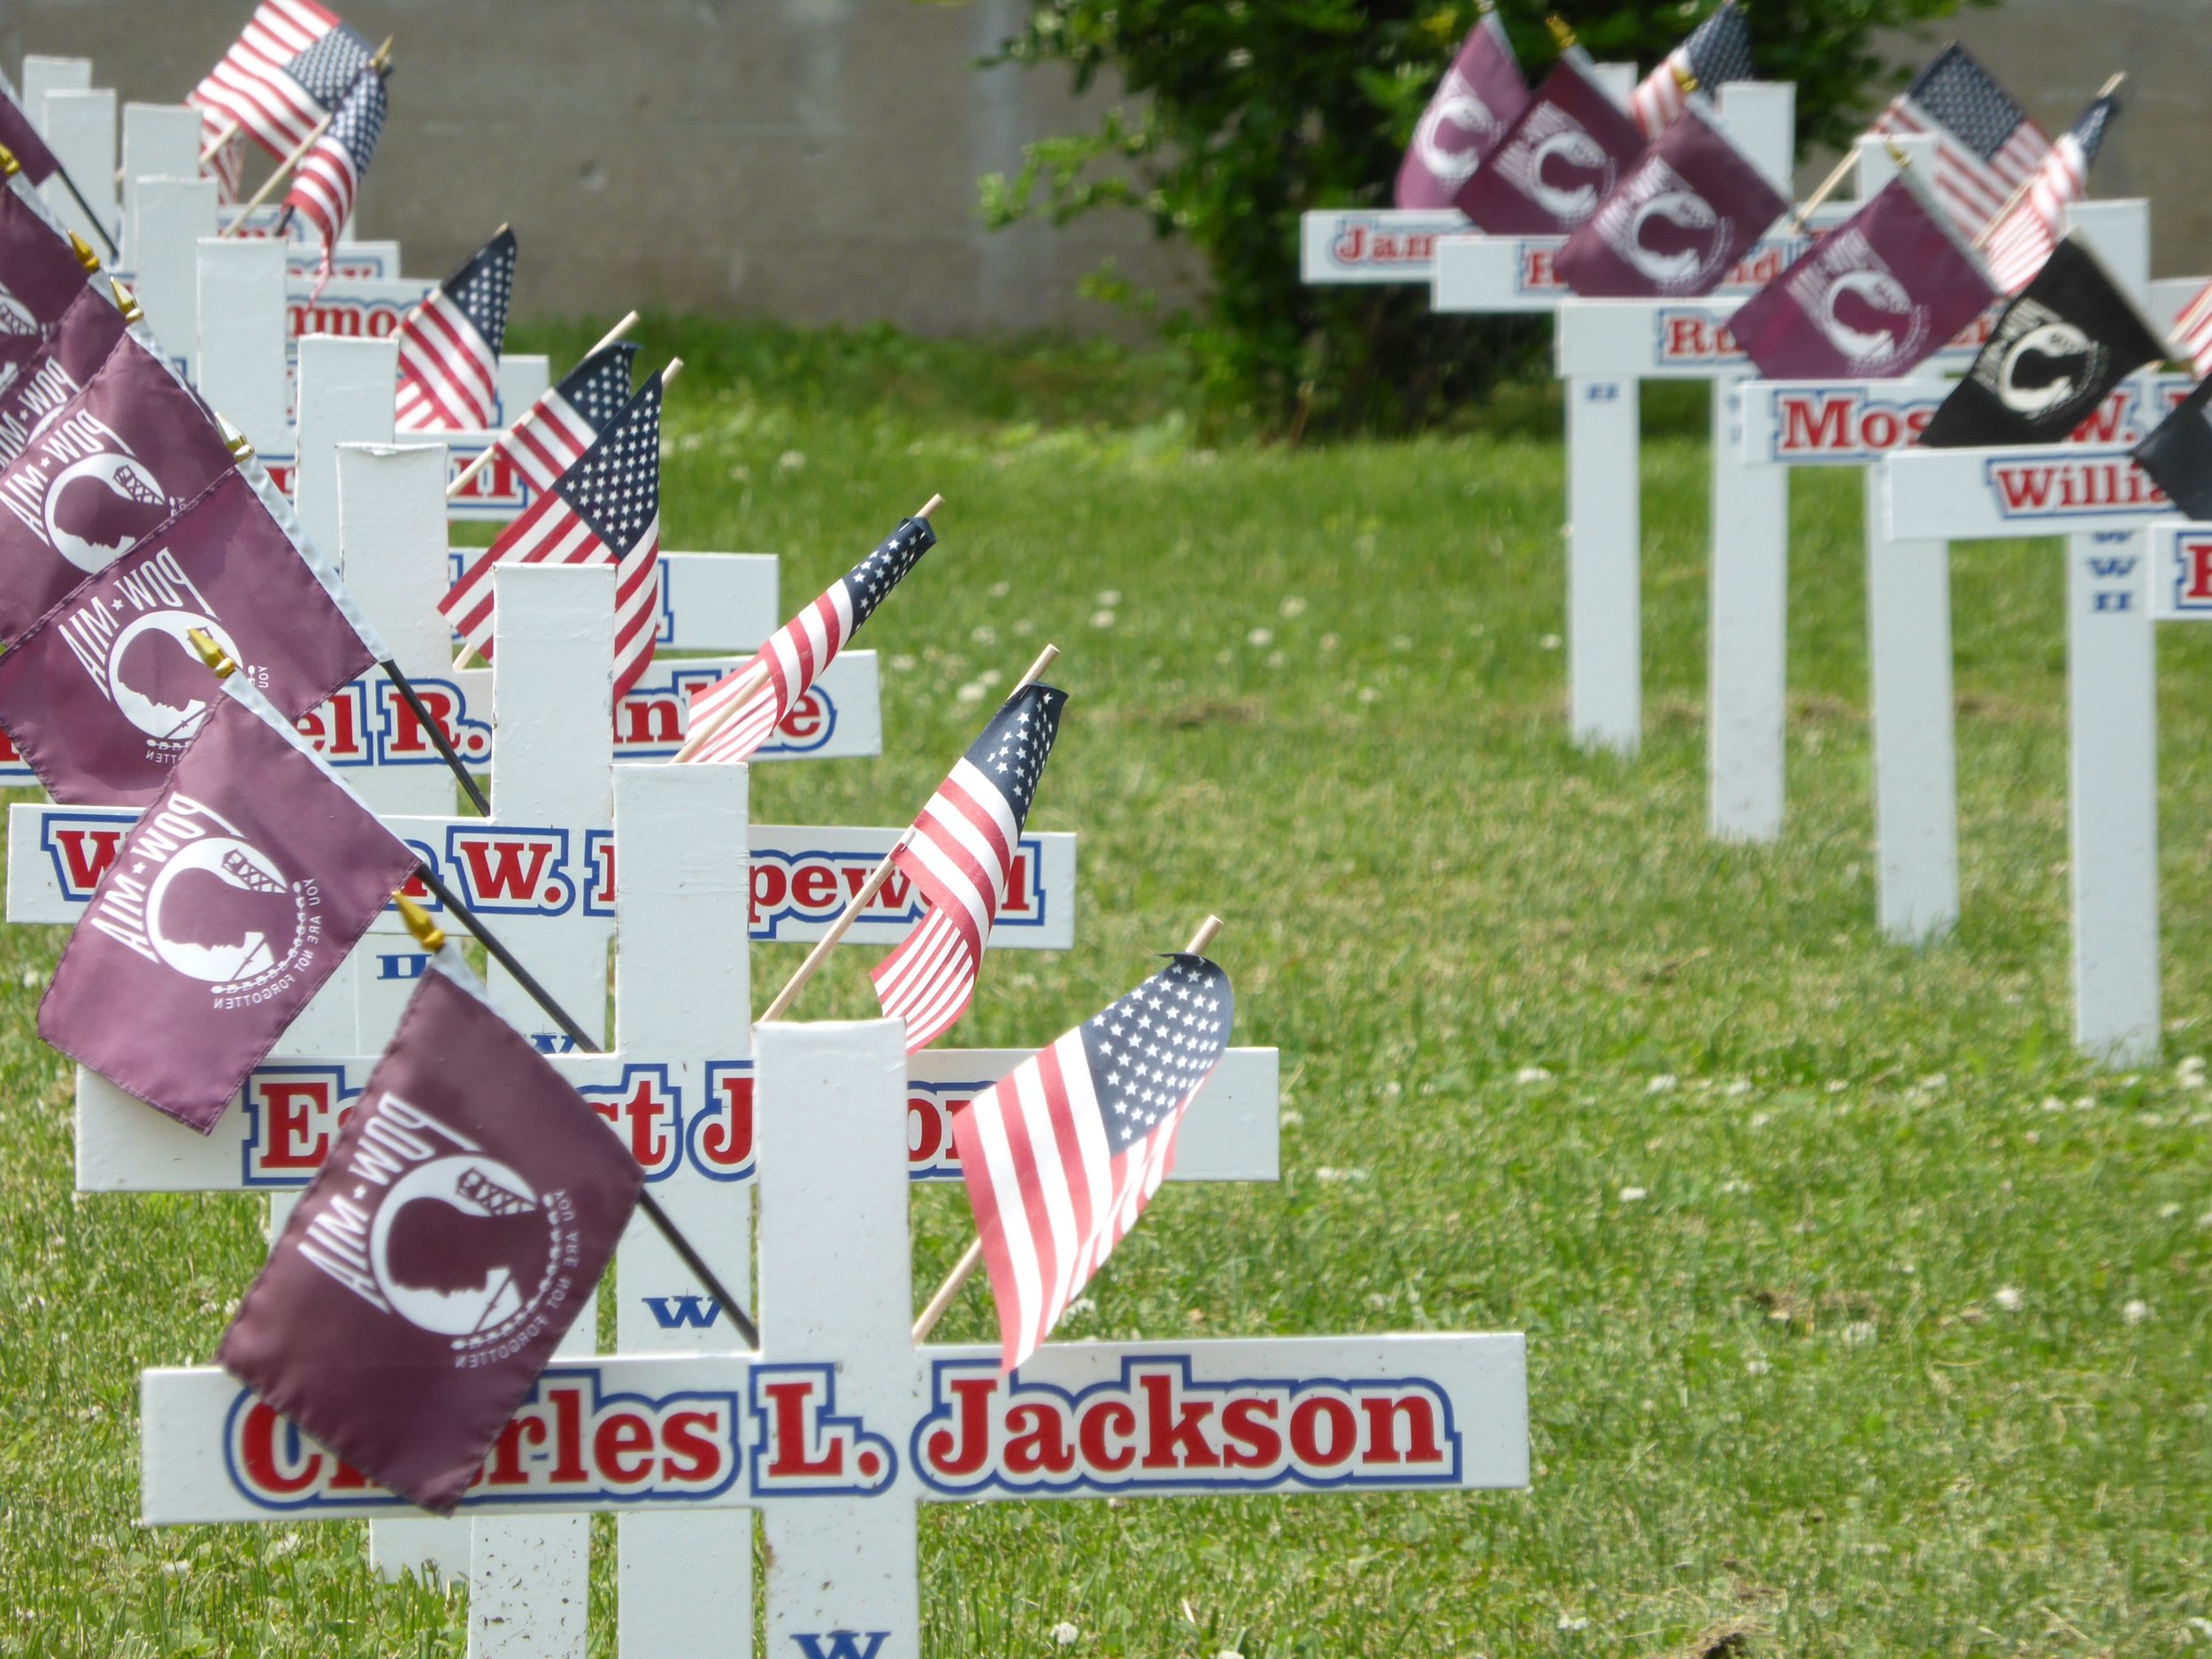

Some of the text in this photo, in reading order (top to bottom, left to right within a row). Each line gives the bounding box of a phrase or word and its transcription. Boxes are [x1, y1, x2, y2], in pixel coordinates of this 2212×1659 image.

[388, 690, 485, 753] R.
[457, 839, 563, 905] W.
[239, 1372, 1445, 1495] Crles L. Jackson
